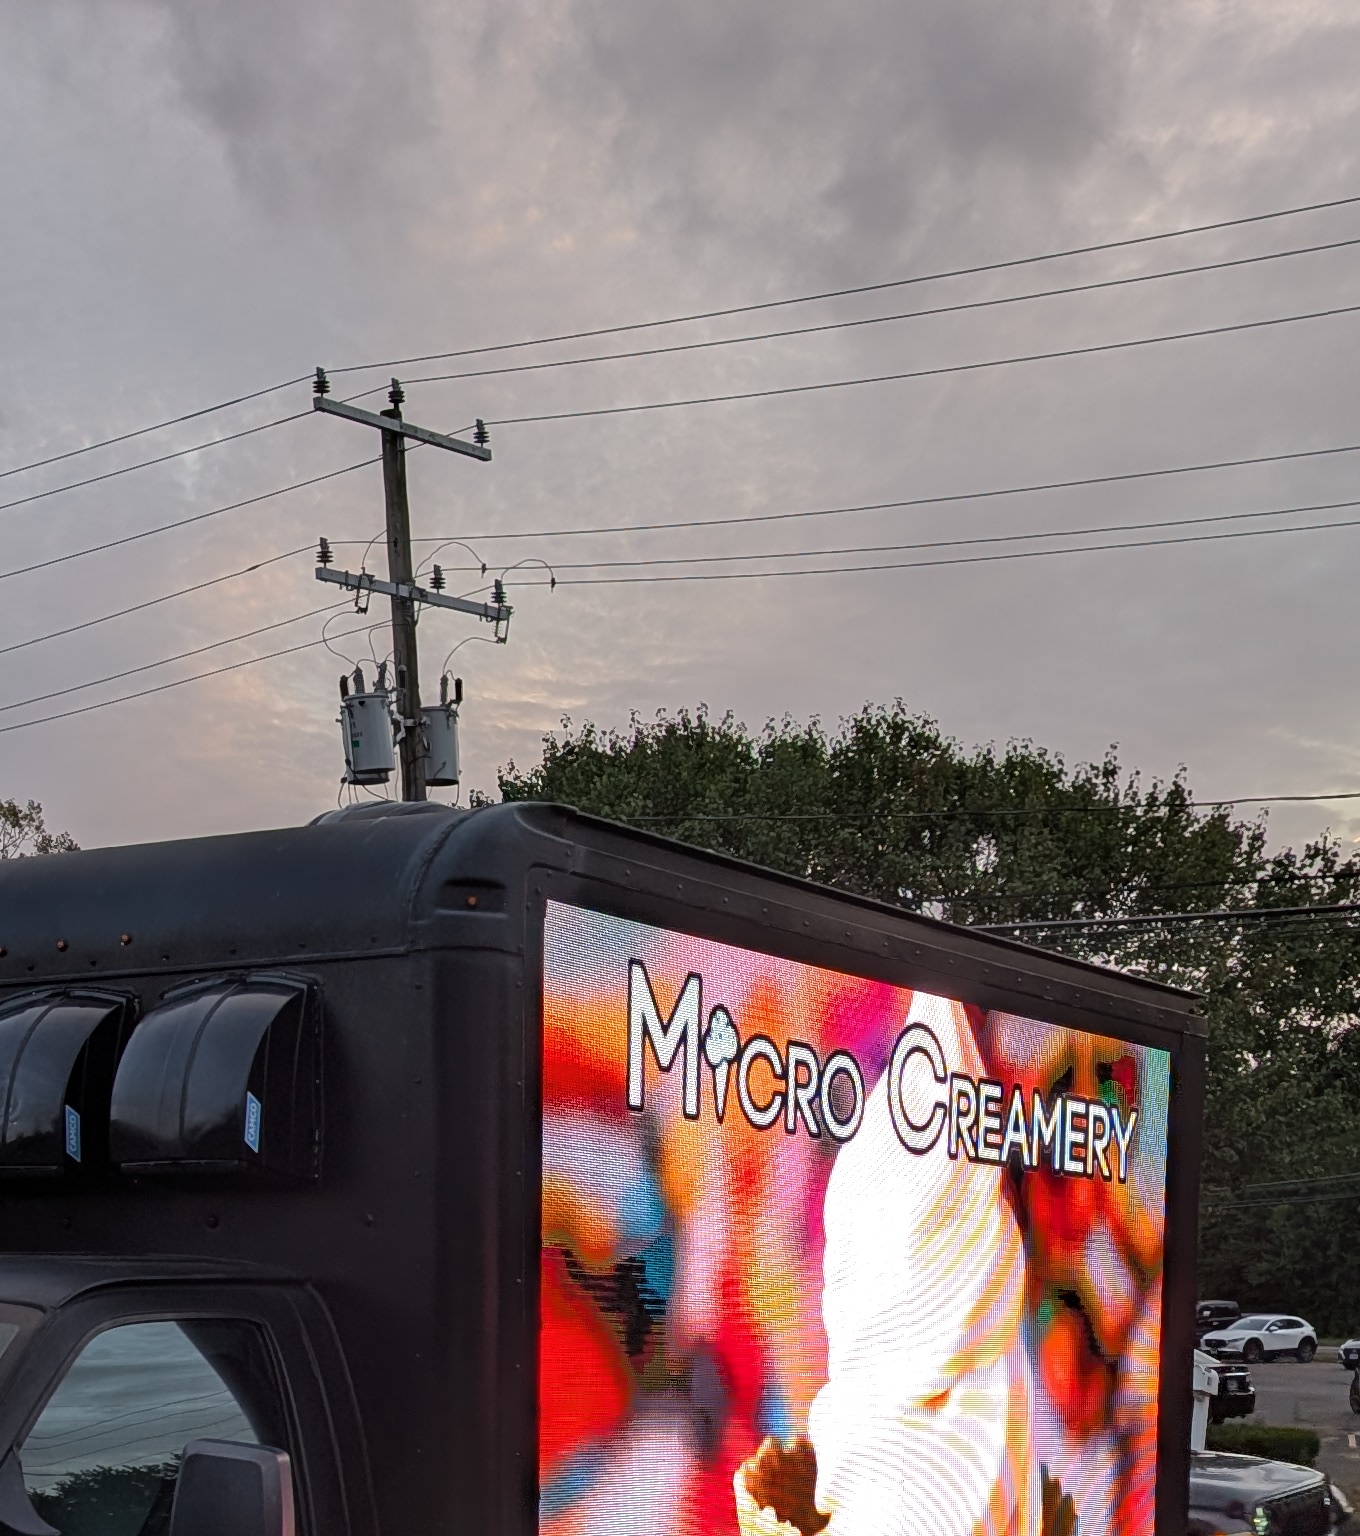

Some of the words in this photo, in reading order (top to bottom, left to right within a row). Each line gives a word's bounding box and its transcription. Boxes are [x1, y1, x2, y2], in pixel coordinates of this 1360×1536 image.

[247, 1102, 257, 1141] CAMCO
[887, 1022, 1138, 1183] CREAMERY
[69, 1114, 77, 1151] CAMCO
